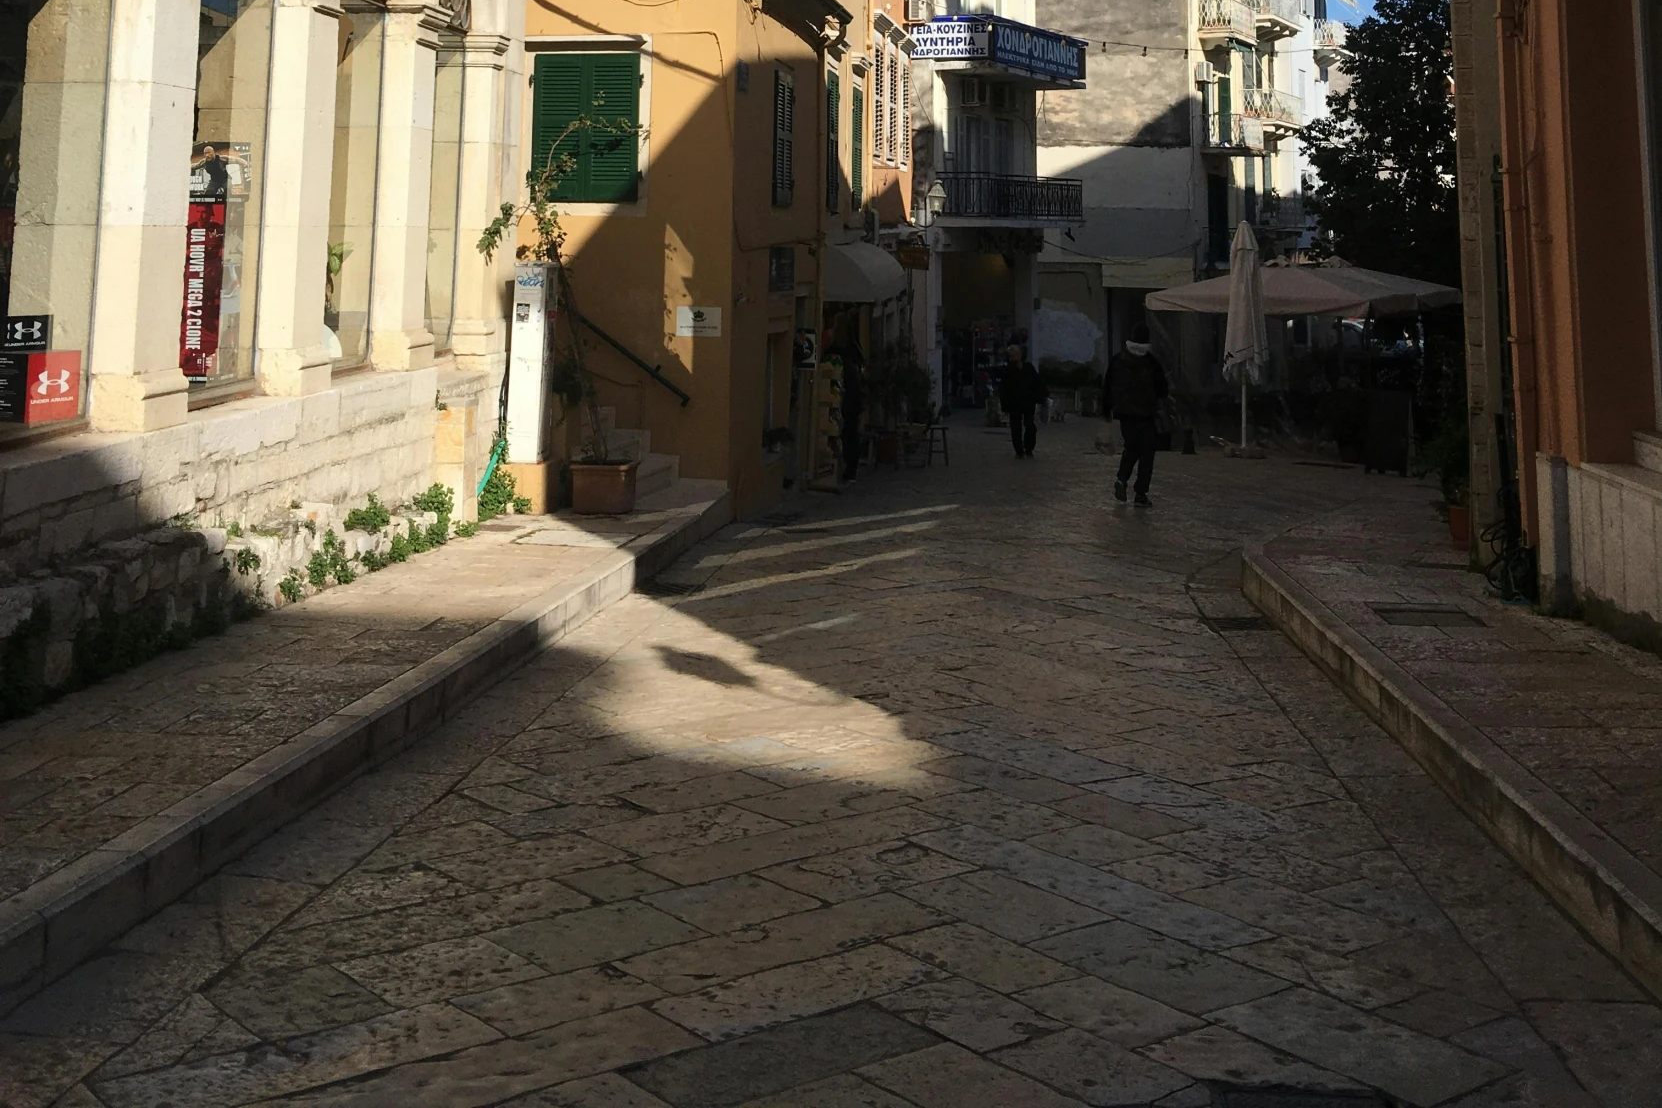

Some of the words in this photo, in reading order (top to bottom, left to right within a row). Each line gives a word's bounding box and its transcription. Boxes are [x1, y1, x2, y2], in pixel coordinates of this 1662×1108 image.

[190, 228, 206, 242] UA
[187, 278, 204, 308] MEGA
[185, 318, 201, 350] CLONE
[50, 395, 74, 403] ARMOUR
